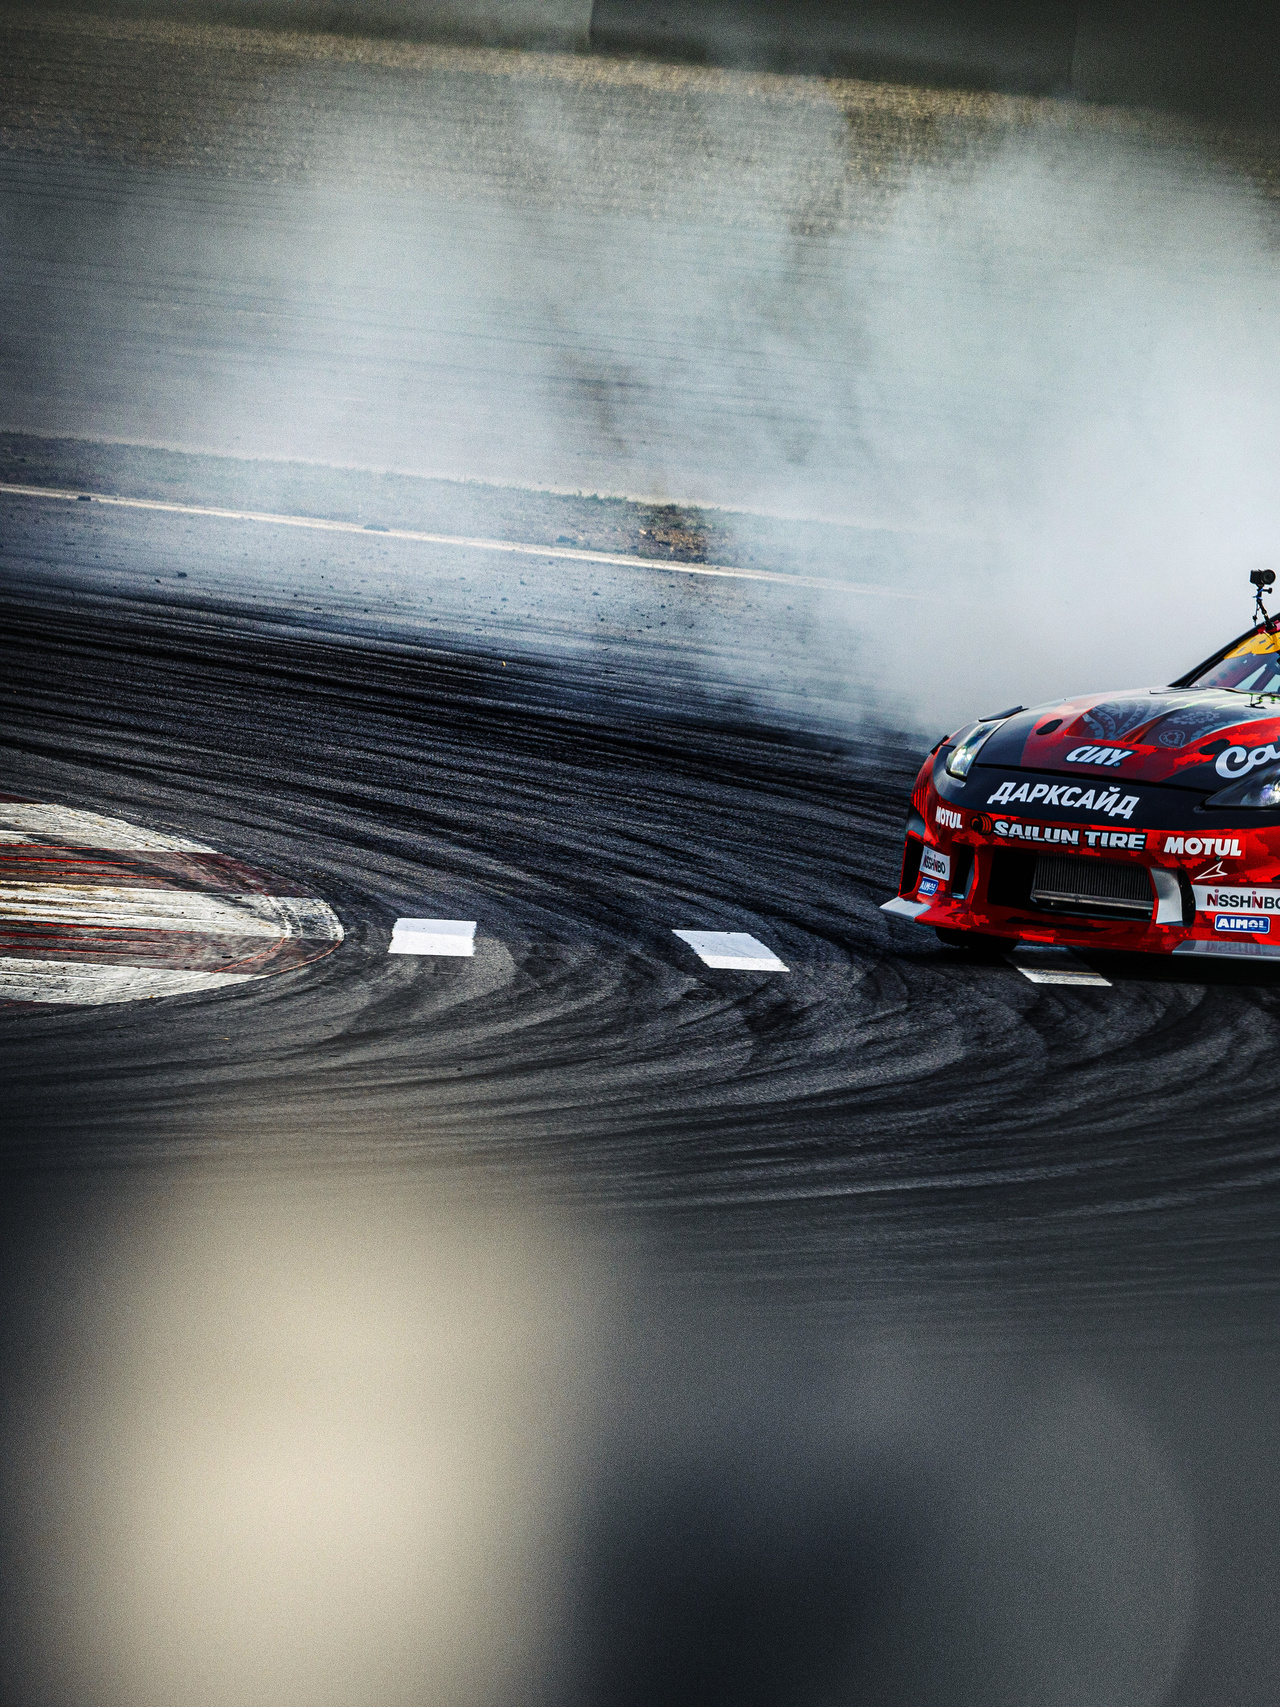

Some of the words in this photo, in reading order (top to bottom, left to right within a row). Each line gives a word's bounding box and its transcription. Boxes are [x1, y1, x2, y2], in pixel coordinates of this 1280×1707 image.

[987, 781, 1141, 820] ДАРКСАЙД
[935, 806, 963, 829] MOTUL
[993, 820, 1080, 846] SAILUN
[1084, 829, 1147, 850] TIRE
[1164, 836, 1243, 857] MOTUL
[1217, 917, 1267, 930] AIMOL
